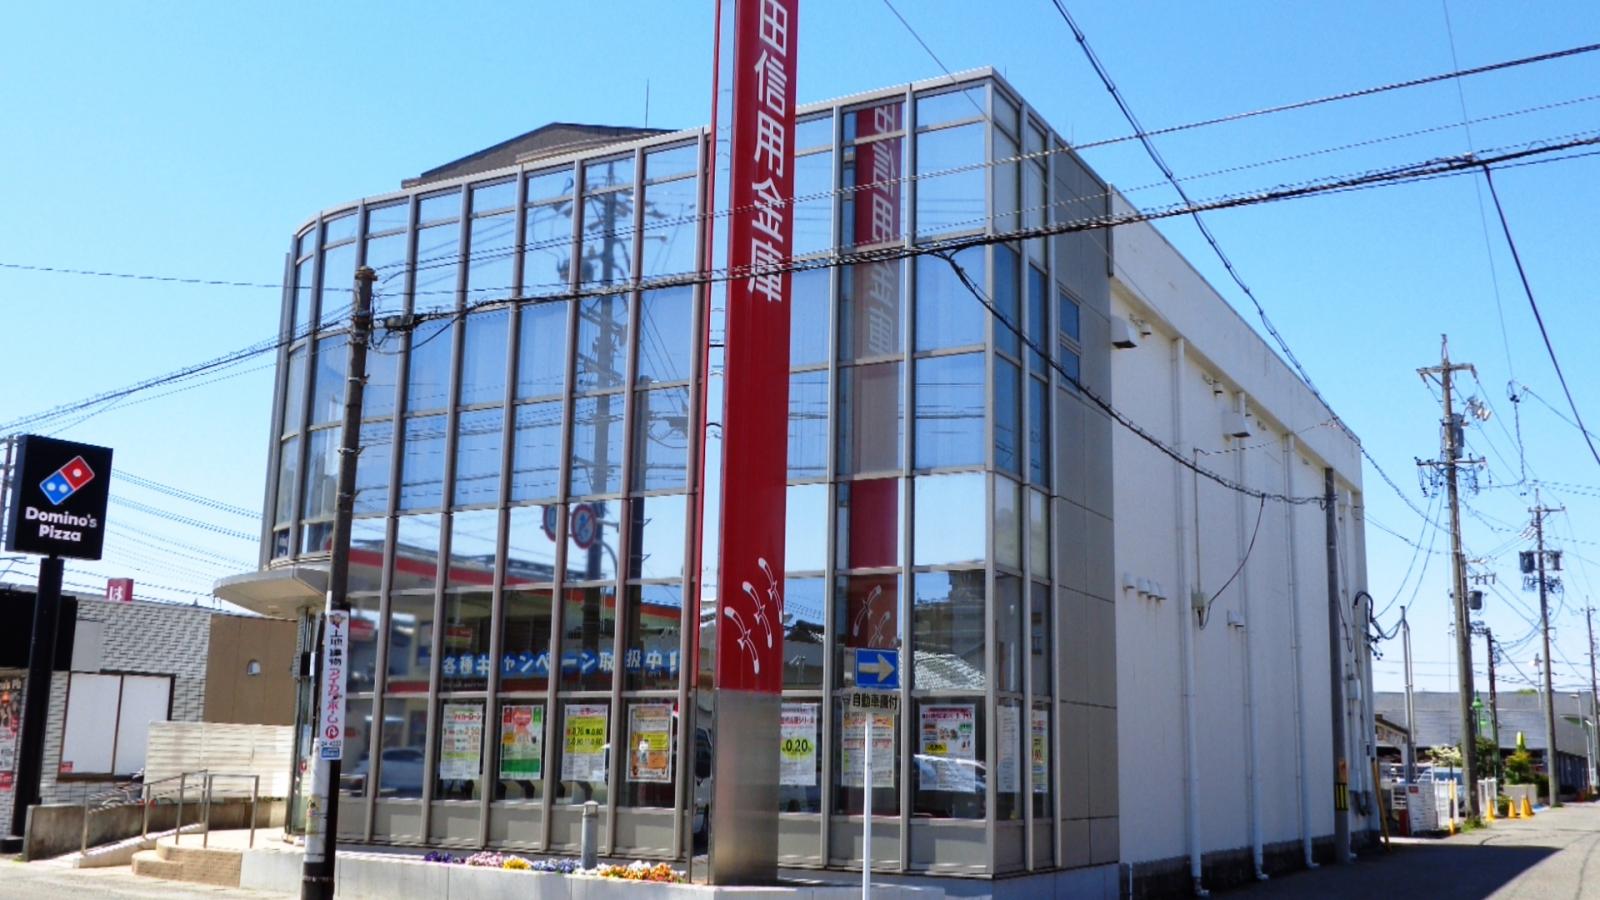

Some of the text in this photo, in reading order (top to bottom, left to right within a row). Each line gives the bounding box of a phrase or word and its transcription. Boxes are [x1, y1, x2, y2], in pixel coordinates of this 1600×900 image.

[748, 0, 789, 303] 田信用金庫
[25, 506, 97, 528] Domino's
[38, 523, 82, 542] Pizza
[785, 739, 808, 752] 0.20
